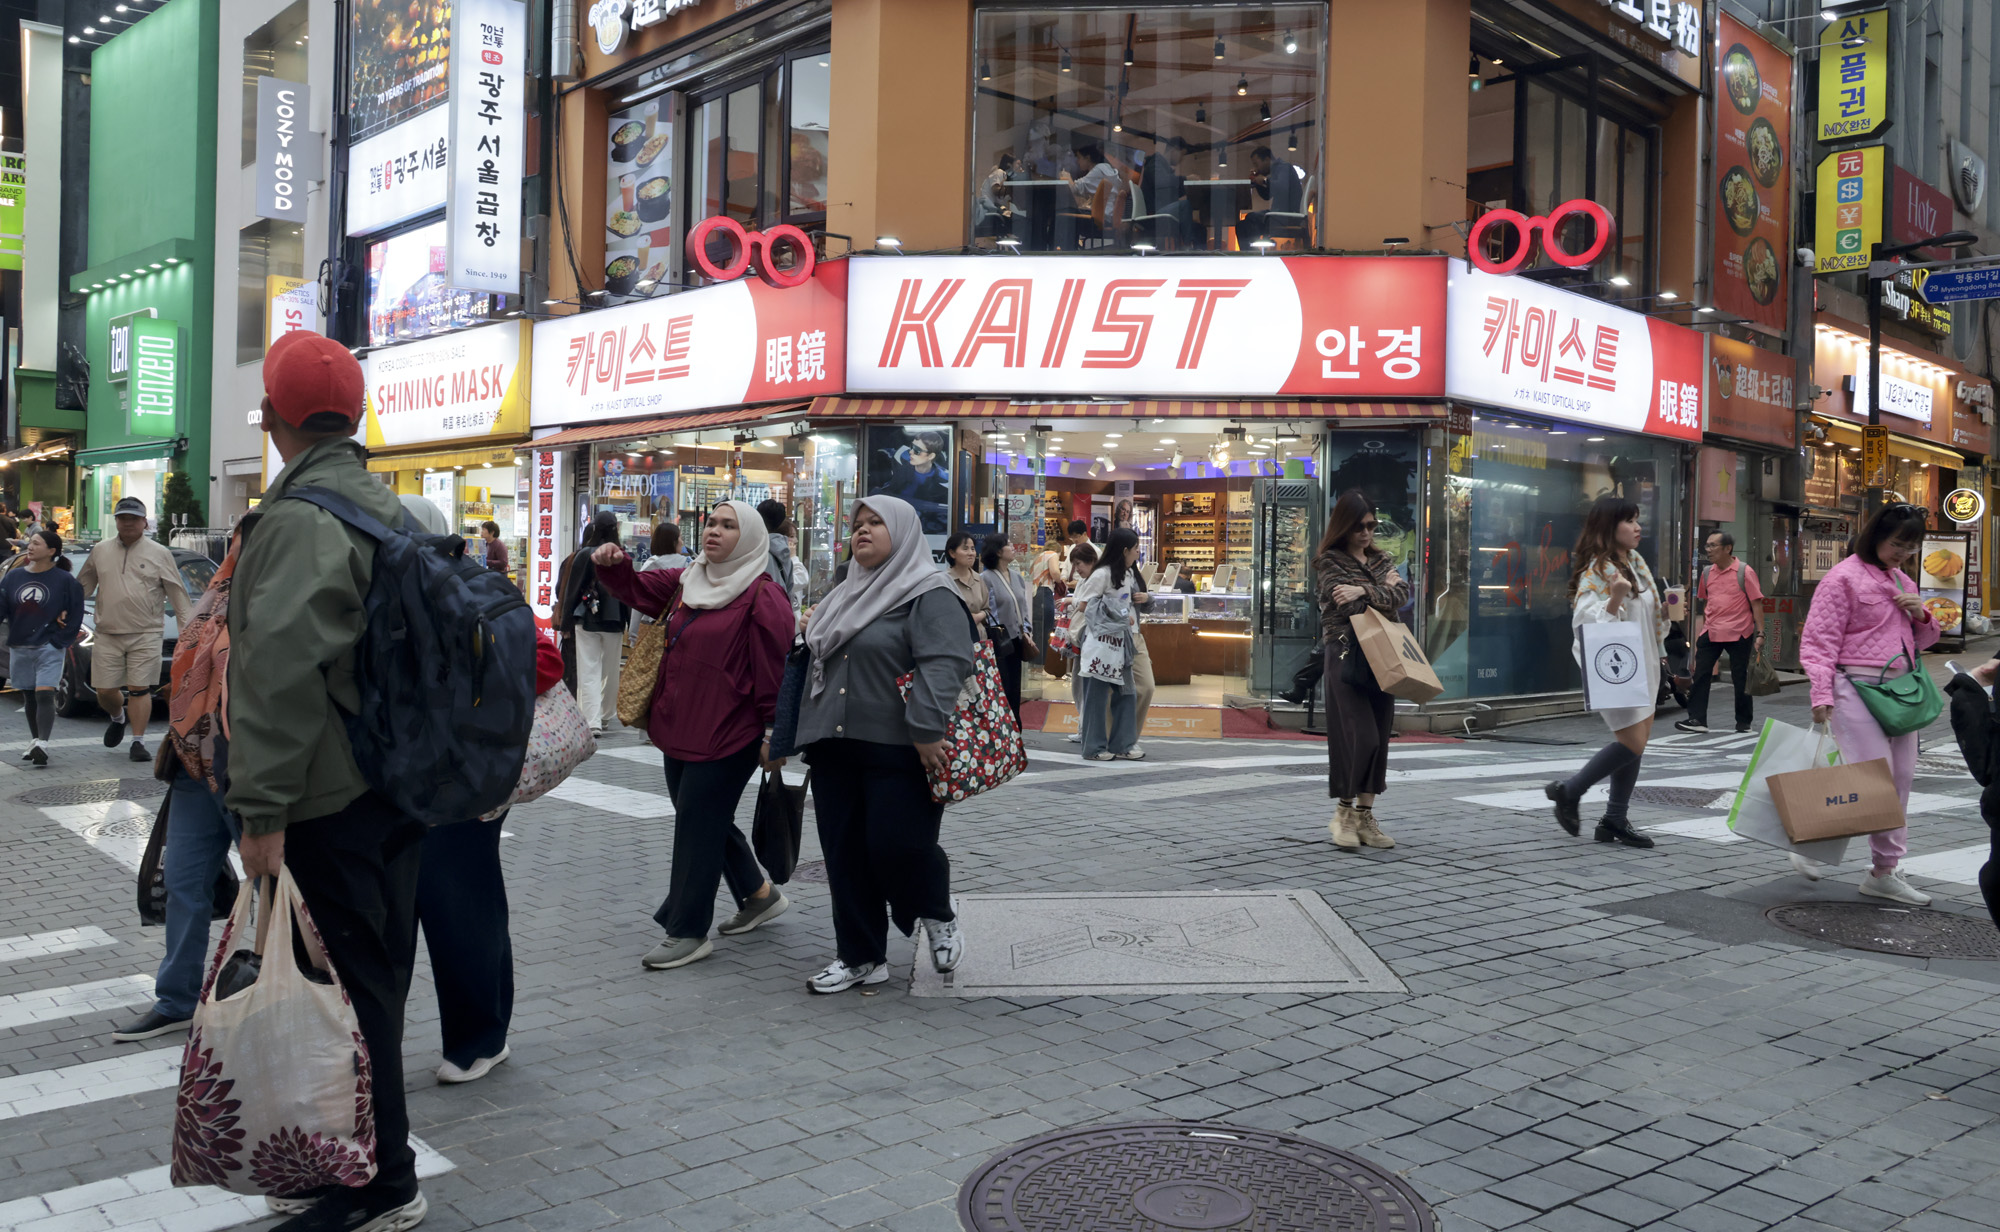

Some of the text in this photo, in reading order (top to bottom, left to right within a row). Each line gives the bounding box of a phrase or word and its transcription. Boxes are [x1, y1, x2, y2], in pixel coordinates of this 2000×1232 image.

[1838, 17, 1869, 118] 상품권
[274, 90, 295, 210] COZY MOOD
[394, 150, 419, 184] 광주
[475, 71, 505, 247] 광주 서울 곱창
[1908, 182, 1937, 236] Hotz
[279, 288, 310, 297] COSMETICS
[490, 271, 507, 280] 1949
[1886, 280, 1910, 320] Sharp
[1940, 284, 1987, 293] Myeongdong
[1956, 270, 1998, 284] 명동8나길
[878, 279, 1252, 370] KAIST
[1910, 299, 1920, 318] 3F
[566, 314, 694, 396] 카이스트
[765, 330, 826, 385] 眼鏡
[1315, 325, 1423, 381] 안경
[1482, 296, 1620, 392] 카이스트
[134, 335, 174, 416] tenzero
[377, 364, 503, 415] SHINING MASK
[623, 397, 645, 408] OPTICAL
[647, 394, 662, 406] SHOP
[1533, 390, 1551, 404] KAIST
[1551, 394, 1575, 410] OPTICAL
[1576, 399, 1591, 412] SHOP
[1659, 379, 1698, 429] 眼鏡
[1825, 793, 1859, 806] MLB
